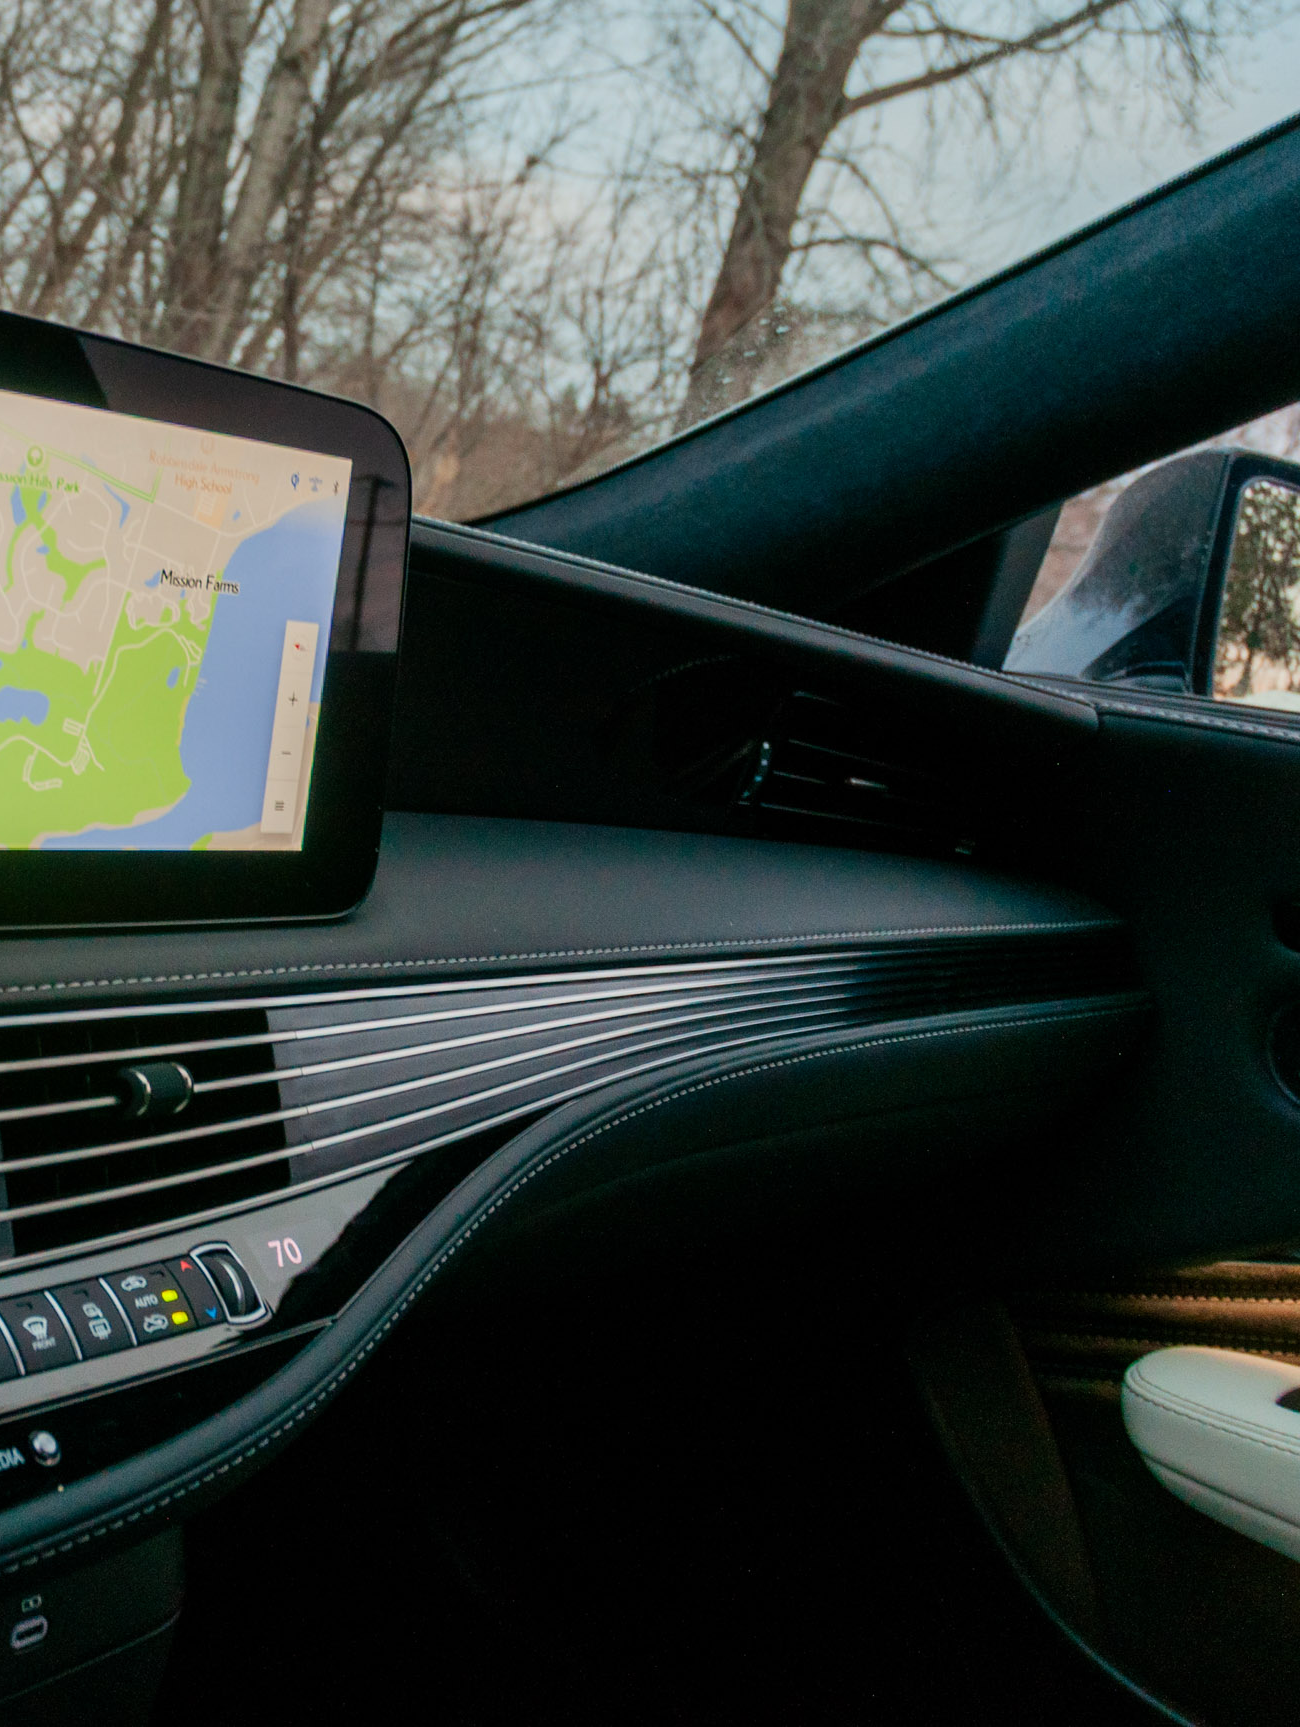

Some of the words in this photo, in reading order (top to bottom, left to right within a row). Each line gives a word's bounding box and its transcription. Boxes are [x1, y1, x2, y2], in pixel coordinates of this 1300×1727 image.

[160, 568, 203, 590] Mission
[206, 574, 240, 595] Farms
[267, 1236, 303, 1268] 70
[134, 1293, 160, 1310] AUTO
